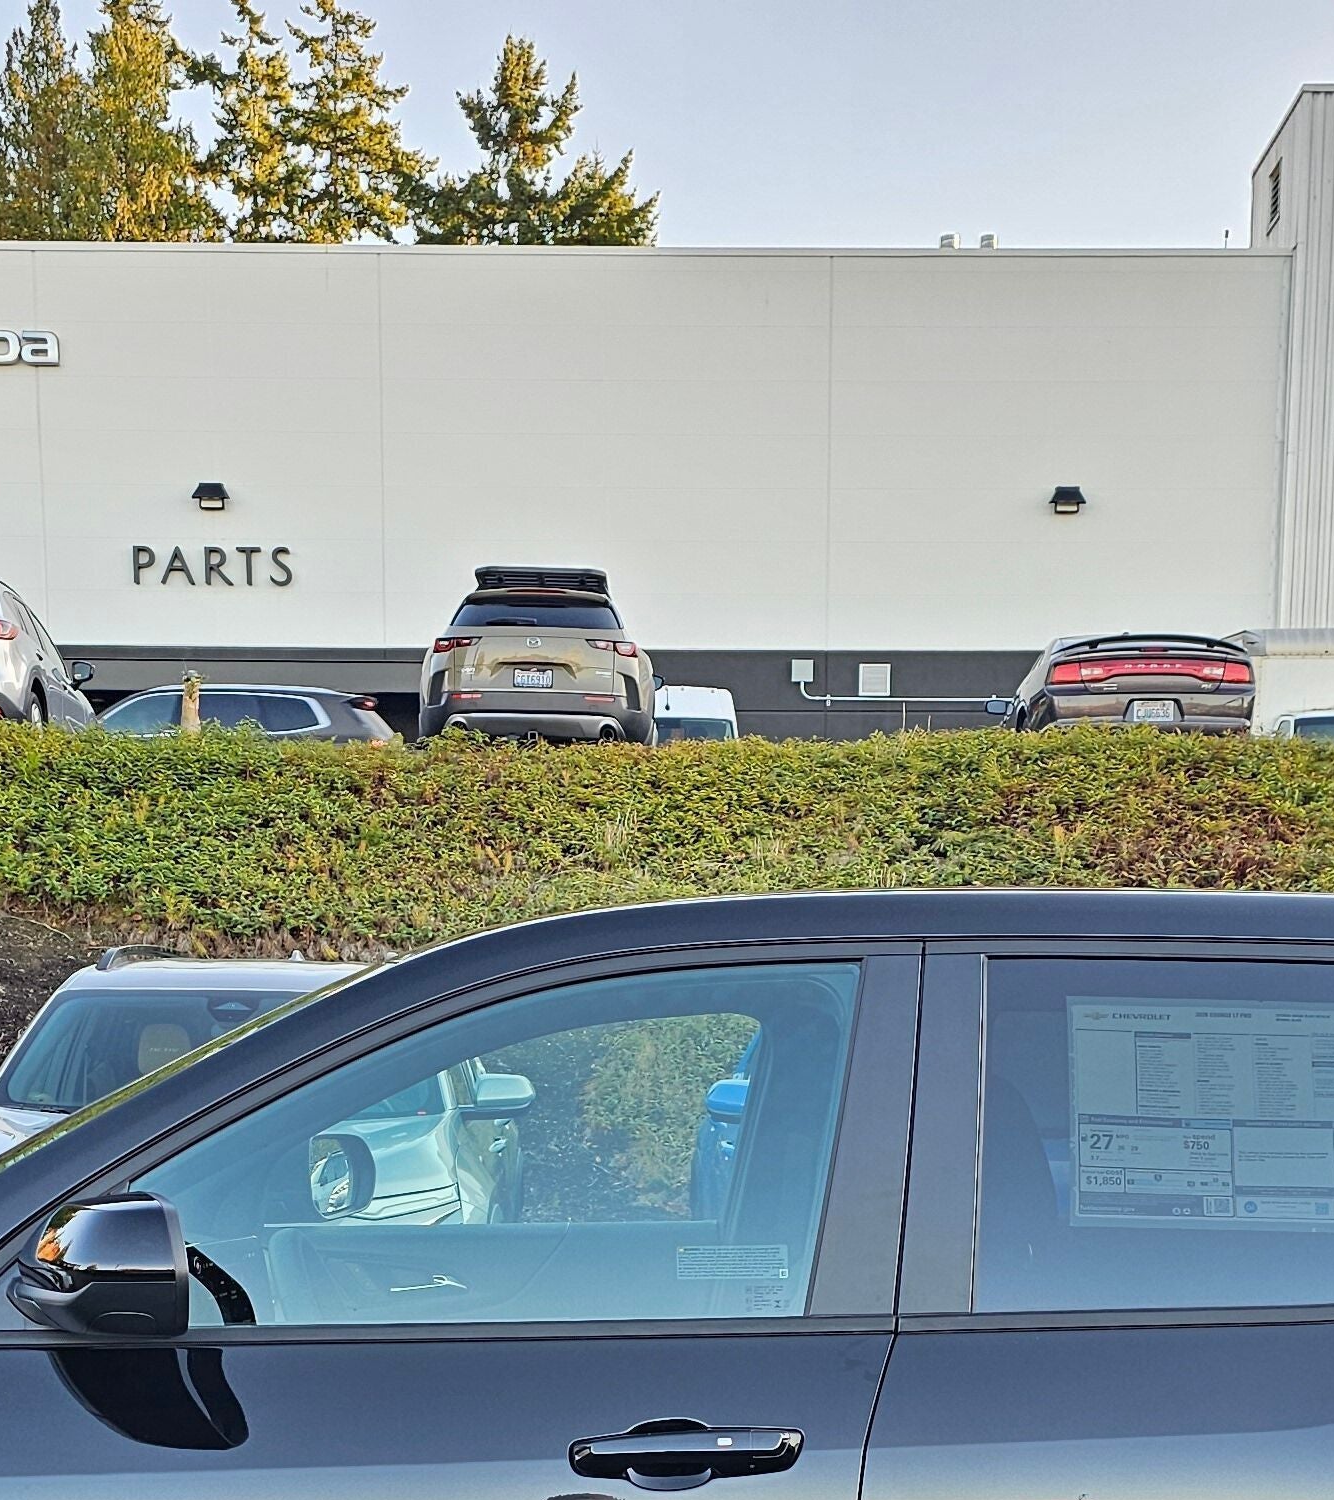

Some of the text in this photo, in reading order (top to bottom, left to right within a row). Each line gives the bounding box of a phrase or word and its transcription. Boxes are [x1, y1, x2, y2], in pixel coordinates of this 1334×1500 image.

[132, 543, 293, 587] PARTS
[1112, 1012, 1171, 1021] CHEVROLET
[1089, 1133, 1114, 1151] 27
[1183, 1141, 1210, 1151] $750
[1085, 1175, 1122, 1188] $1,850
